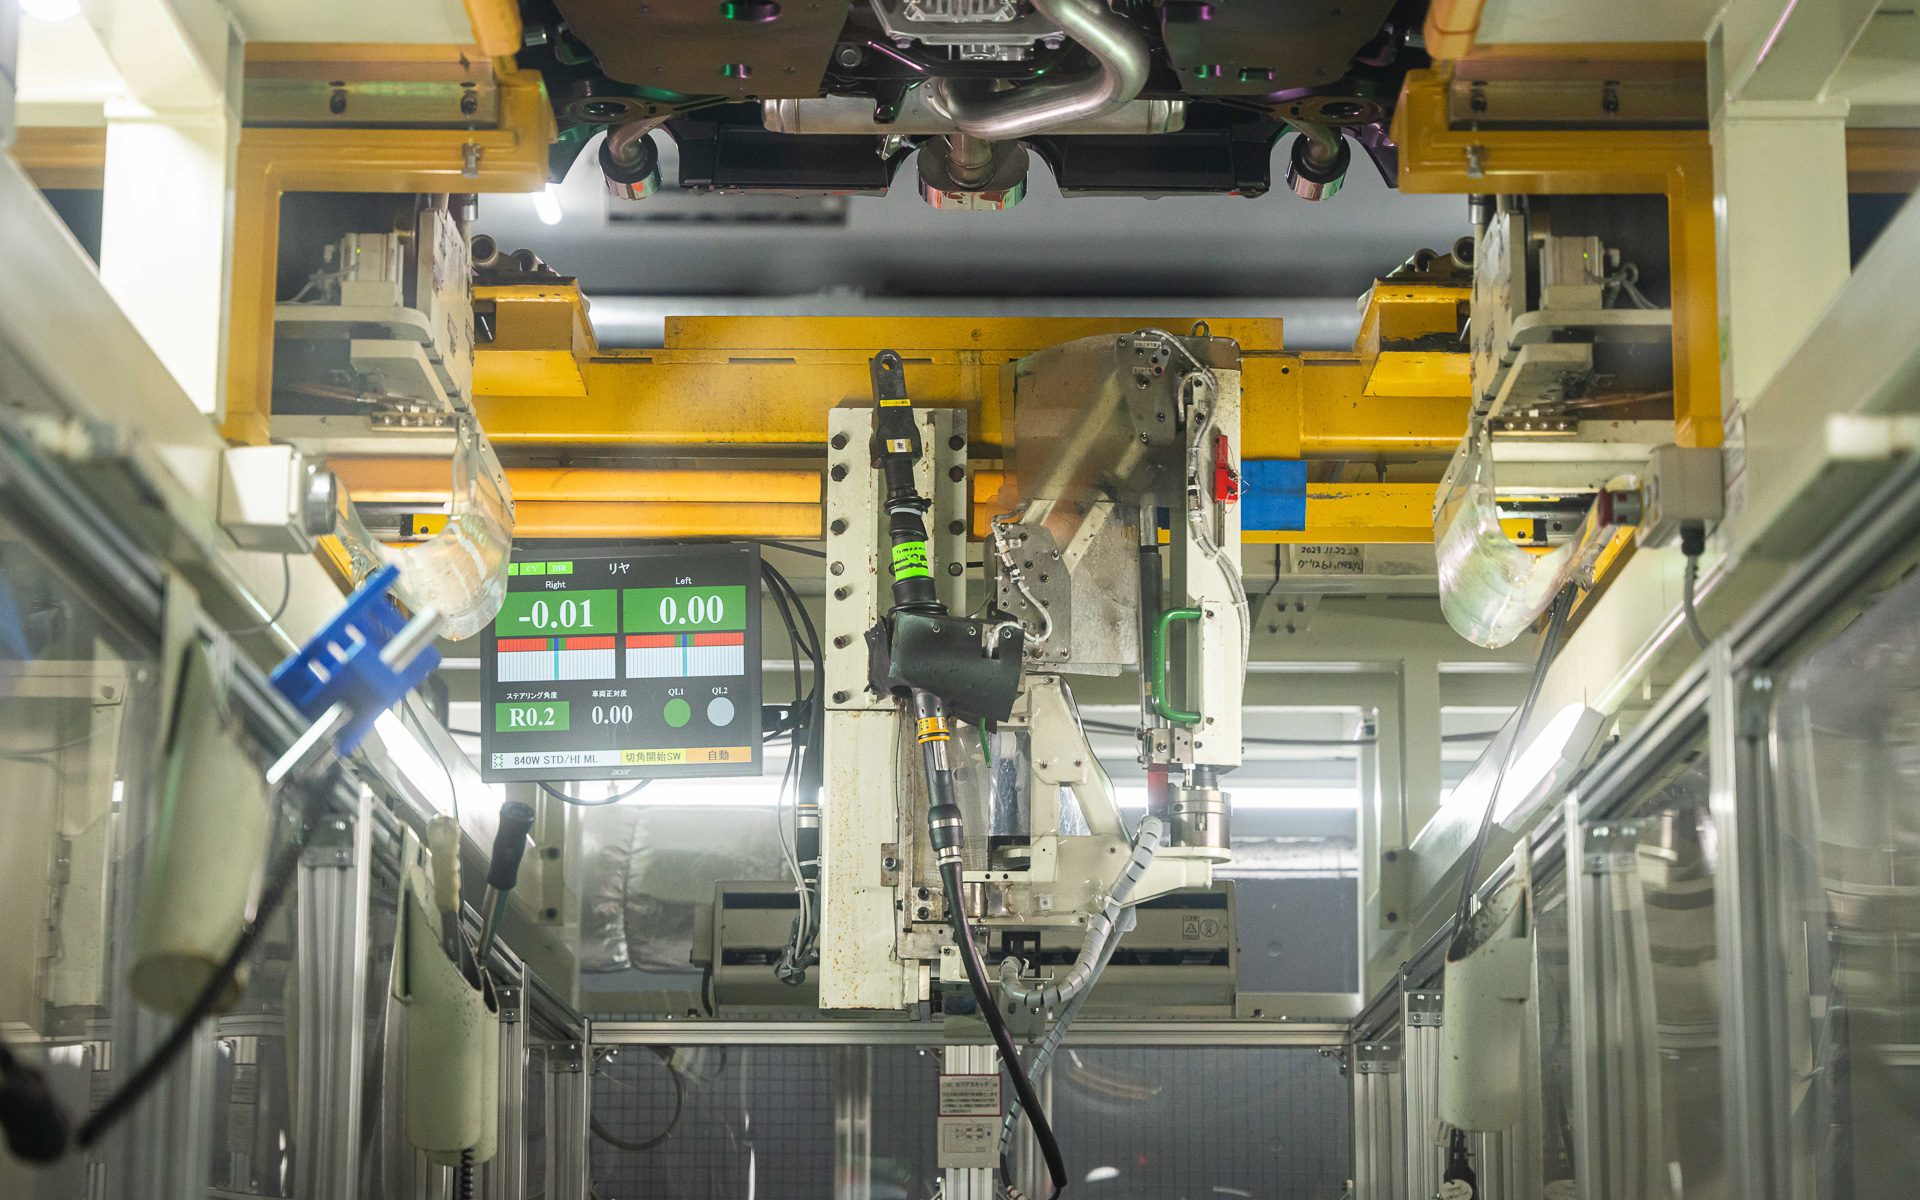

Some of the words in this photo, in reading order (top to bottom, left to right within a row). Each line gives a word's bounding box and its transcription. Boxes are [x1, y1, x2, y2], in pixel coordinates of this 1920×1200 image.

[552, 564, 567, 572] DIR
[609, 563, 630, 575] リヤ
[545, 580, 566, 589] Right
[675, 576, 692, 585] Left
[518, 599, 594, 629] -0.01
[659, 595, 724, 625] 0.00
[506, 691, 558, 700] ステアリング角度
[591, 689, 628, 698] 車両正対度
[668, 688, 684, 697] QL1
[711, 686, 728, 695] QL2
[509, 707, 555, 727] R0.2
[591, 705, 633, 725] 0.00
[514, 756, 540, 765] 840W
[543, 755, 581, 764] STD/HI
[584, 755, 599, 764] ML
[625, 752, 681, 763] 切角開始SW
[708, 750, 730, 761] 自動
